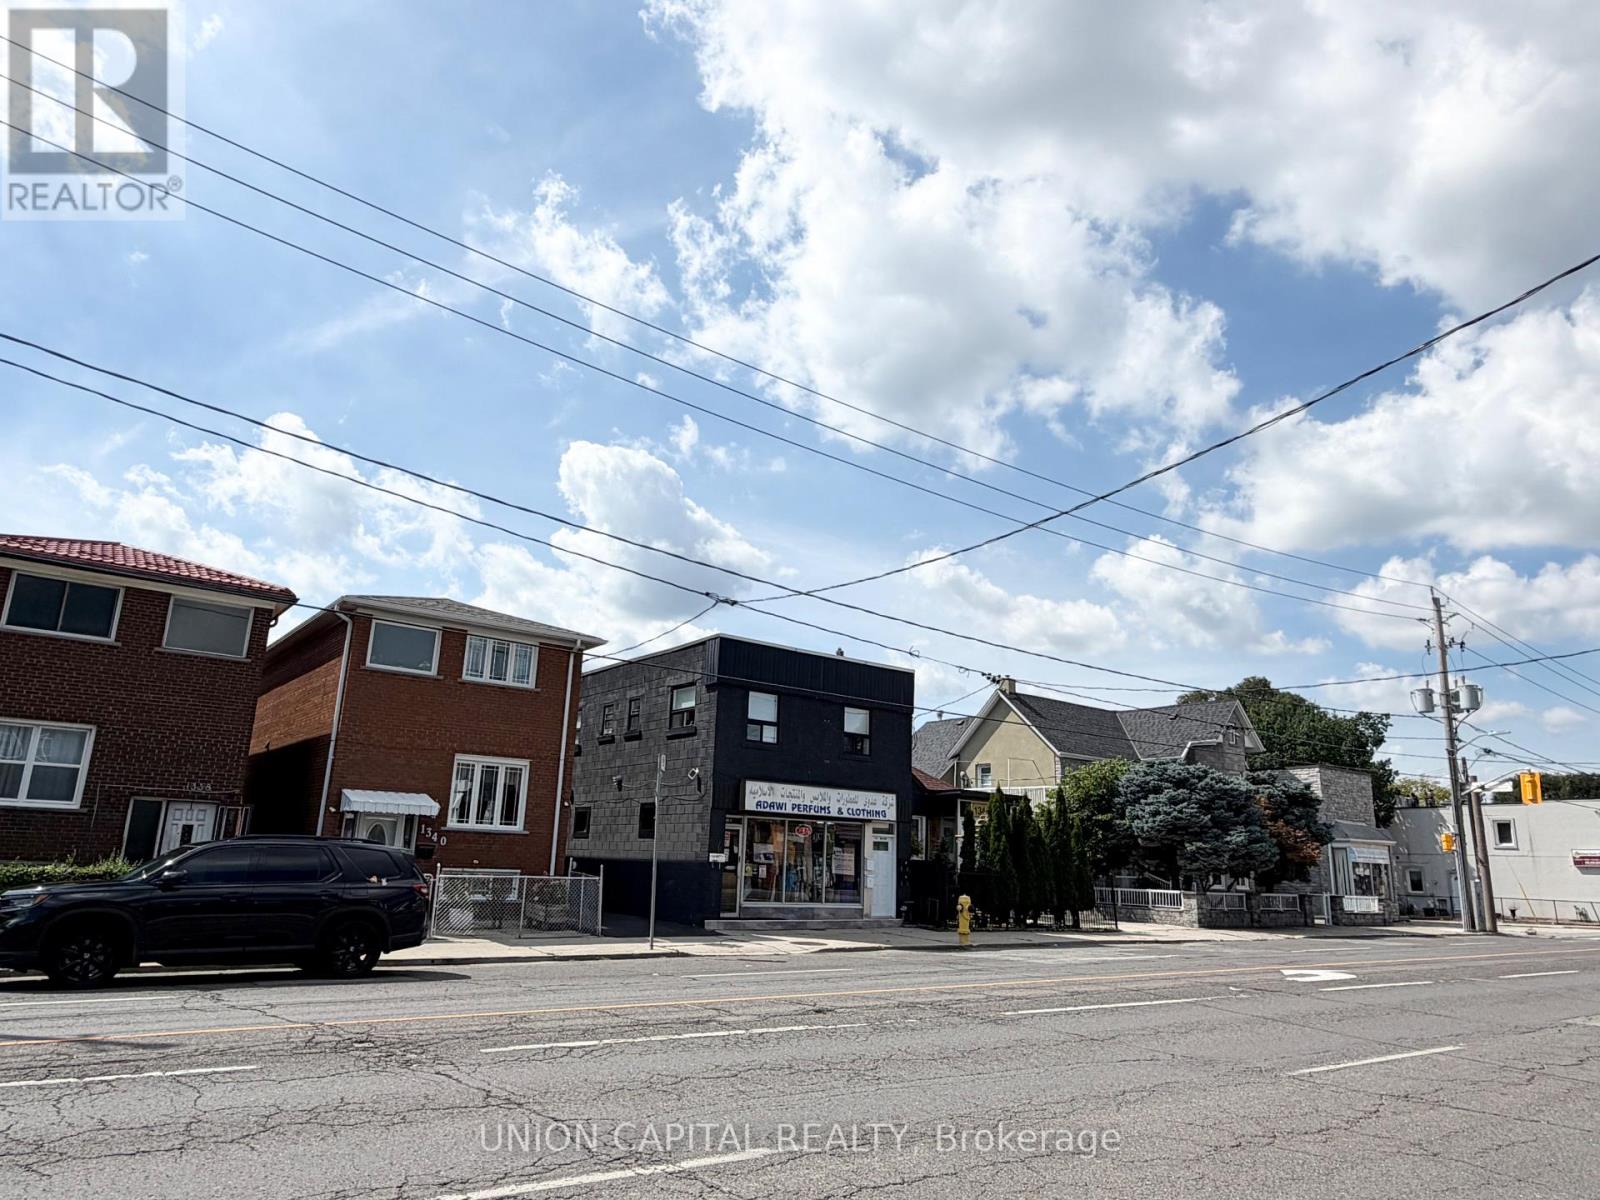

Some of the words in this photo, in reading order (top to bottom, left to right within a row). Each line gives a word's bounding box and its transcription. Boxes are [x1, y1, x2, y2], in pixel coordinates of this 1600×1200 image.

[755, 800, 787, 812] ADAWI
[791, 803, 831, 815] PERFUMS
[837, 807, 844, 816] &
[847, 807, 887, 819] CLOTHING
[421, 824, 447, 846] 1340
